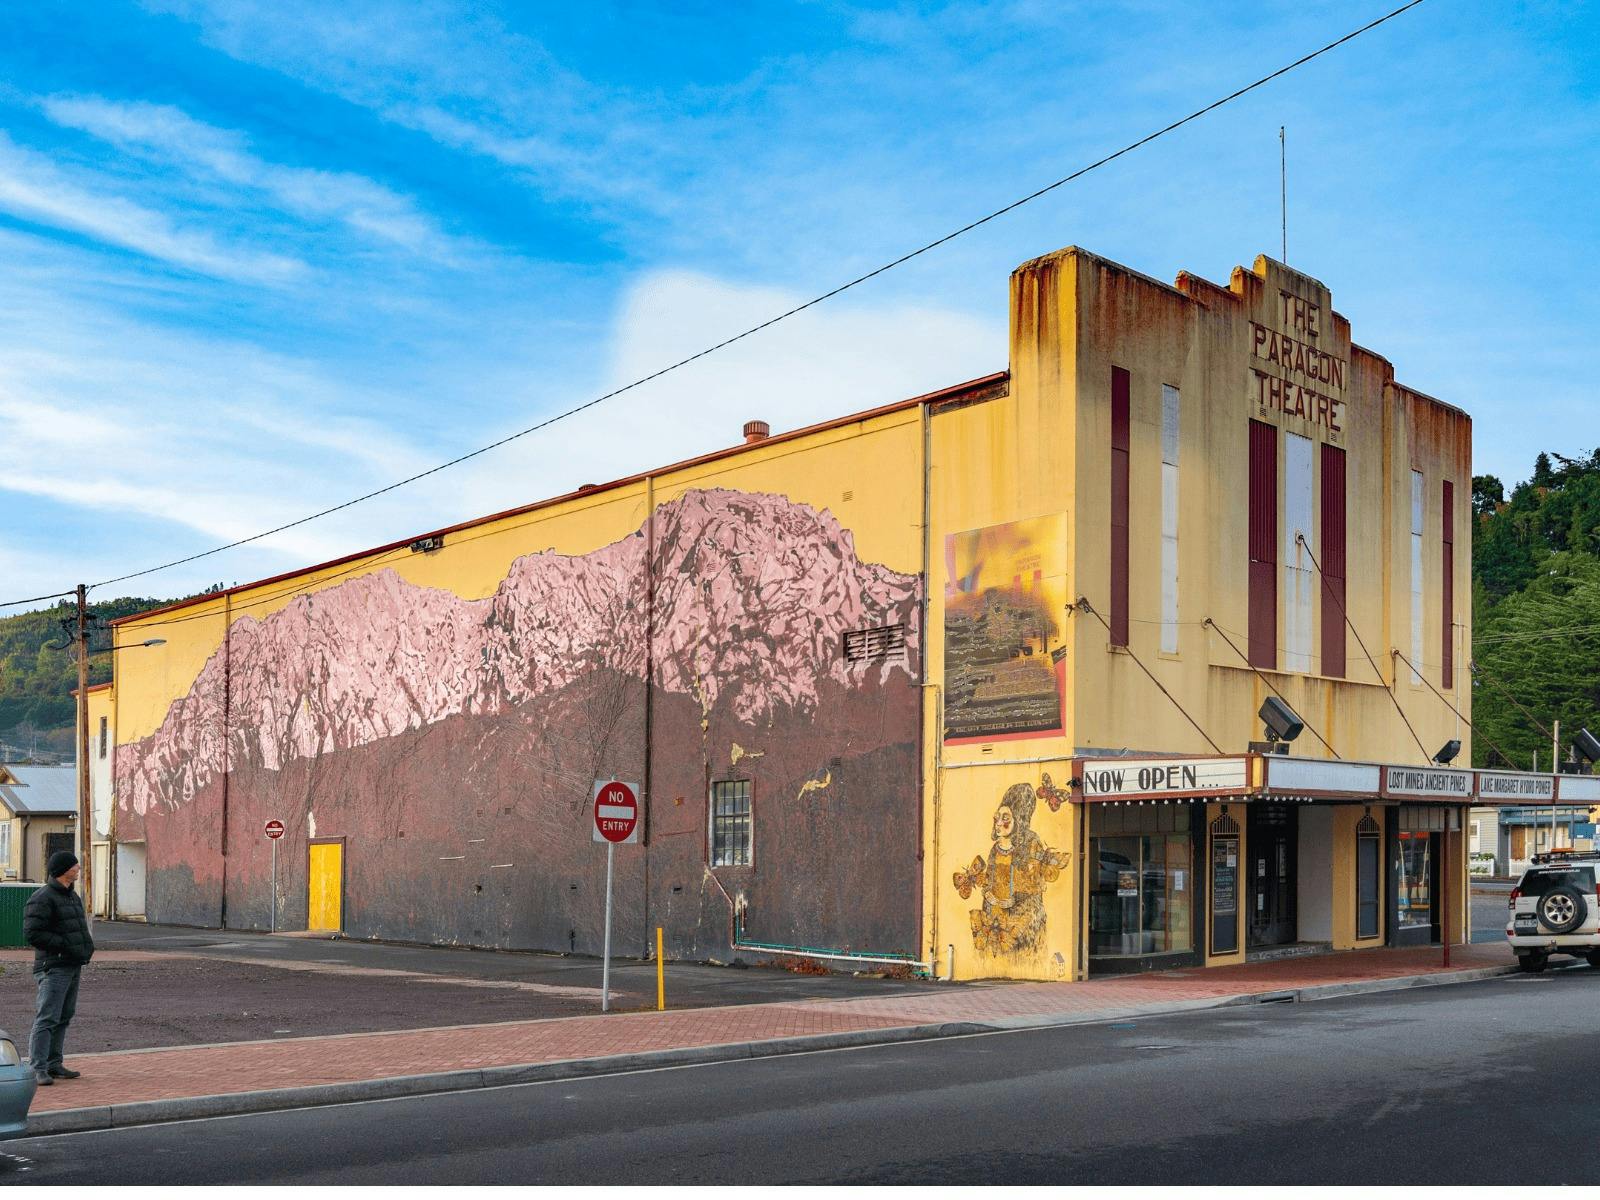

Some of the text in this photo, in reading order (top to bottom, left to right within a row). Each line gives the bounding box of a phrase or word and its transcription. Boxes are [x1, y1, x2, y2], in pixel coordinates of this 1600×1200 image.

[1280, 291, 1319, 337] THE
[1254, 325, 1343, 390] PARAGON
[1255, 369, 1340, 431] THEATRE
[1085, 769, 1125, 794] NOW
[1389, 771, 1466, 792] LOST MINES ANCIENT PINES
[1481, 776, 1551, 795] LAKE MARGARET HYDRO POWER
[609, 791, 624, 803] NO
[602, 820, 629, 831] ENTRY
